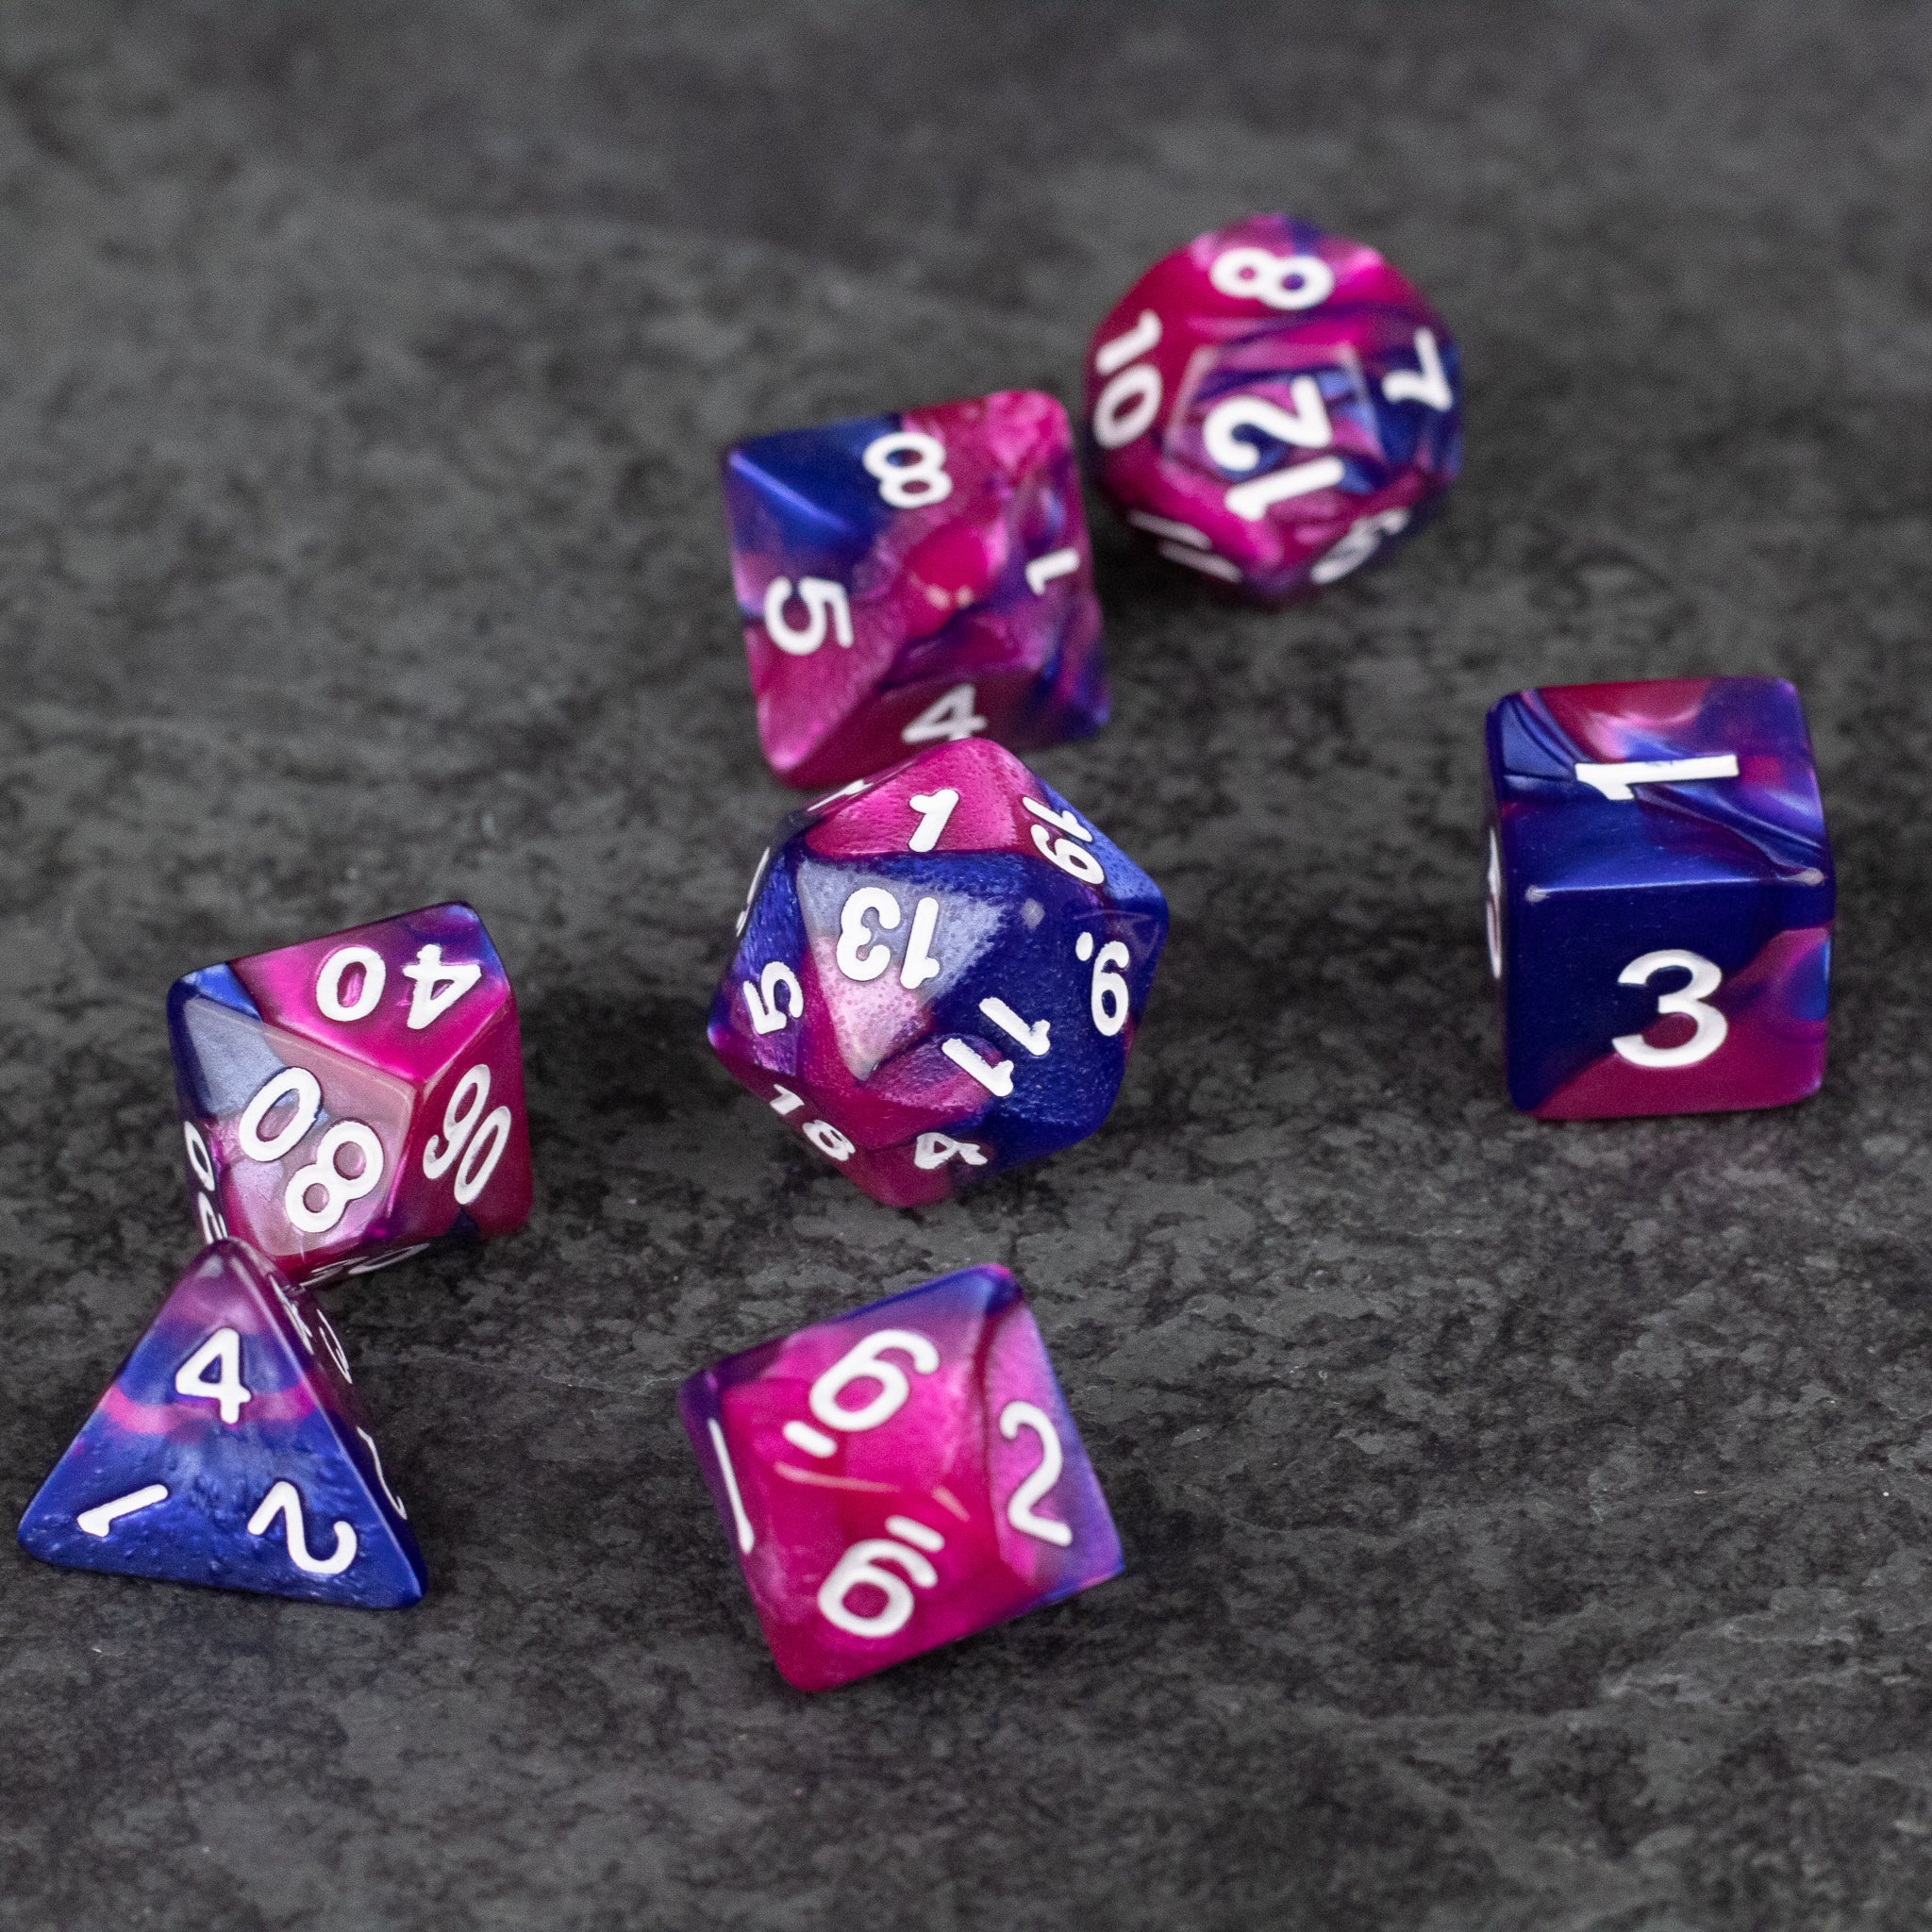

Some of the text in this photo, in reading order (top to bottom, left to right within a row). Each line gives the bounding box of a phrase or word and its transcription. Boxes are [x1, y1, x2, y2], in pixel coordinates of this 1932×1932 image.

[1209, 246, 1335, 310] 8
[1093, 308, 1163, 449] 10
[1381, 327, 1453, 412] 7
[862, 430, 953, 509] 8
[1202, 376, 1345, 523] 12
[1024, 548, 1080, 595] 1
[763, 576, 854, 656] 5
[902, 683, 989, 744] 4
[908, 788, 960, 853] 1
[1574, 754, 1740, 802] 1
[835, 883, 941, 990] 13
[315, 943, 483, 1030] 40
[742, 960, 805, 1035] 5
[1611, 948, 1728, 1069] 3
[941, 996, 1052, 1098] 11
[238, 1065, 385, 1234] 80
[913, 1132, 988, 1171] 4
[175, 1326, 253, 1425] 4
[75, 1483, 170, 1539] 1
[998, 1400, 1074, 1547] 2
[246, 1480, 358, 1579] 2
